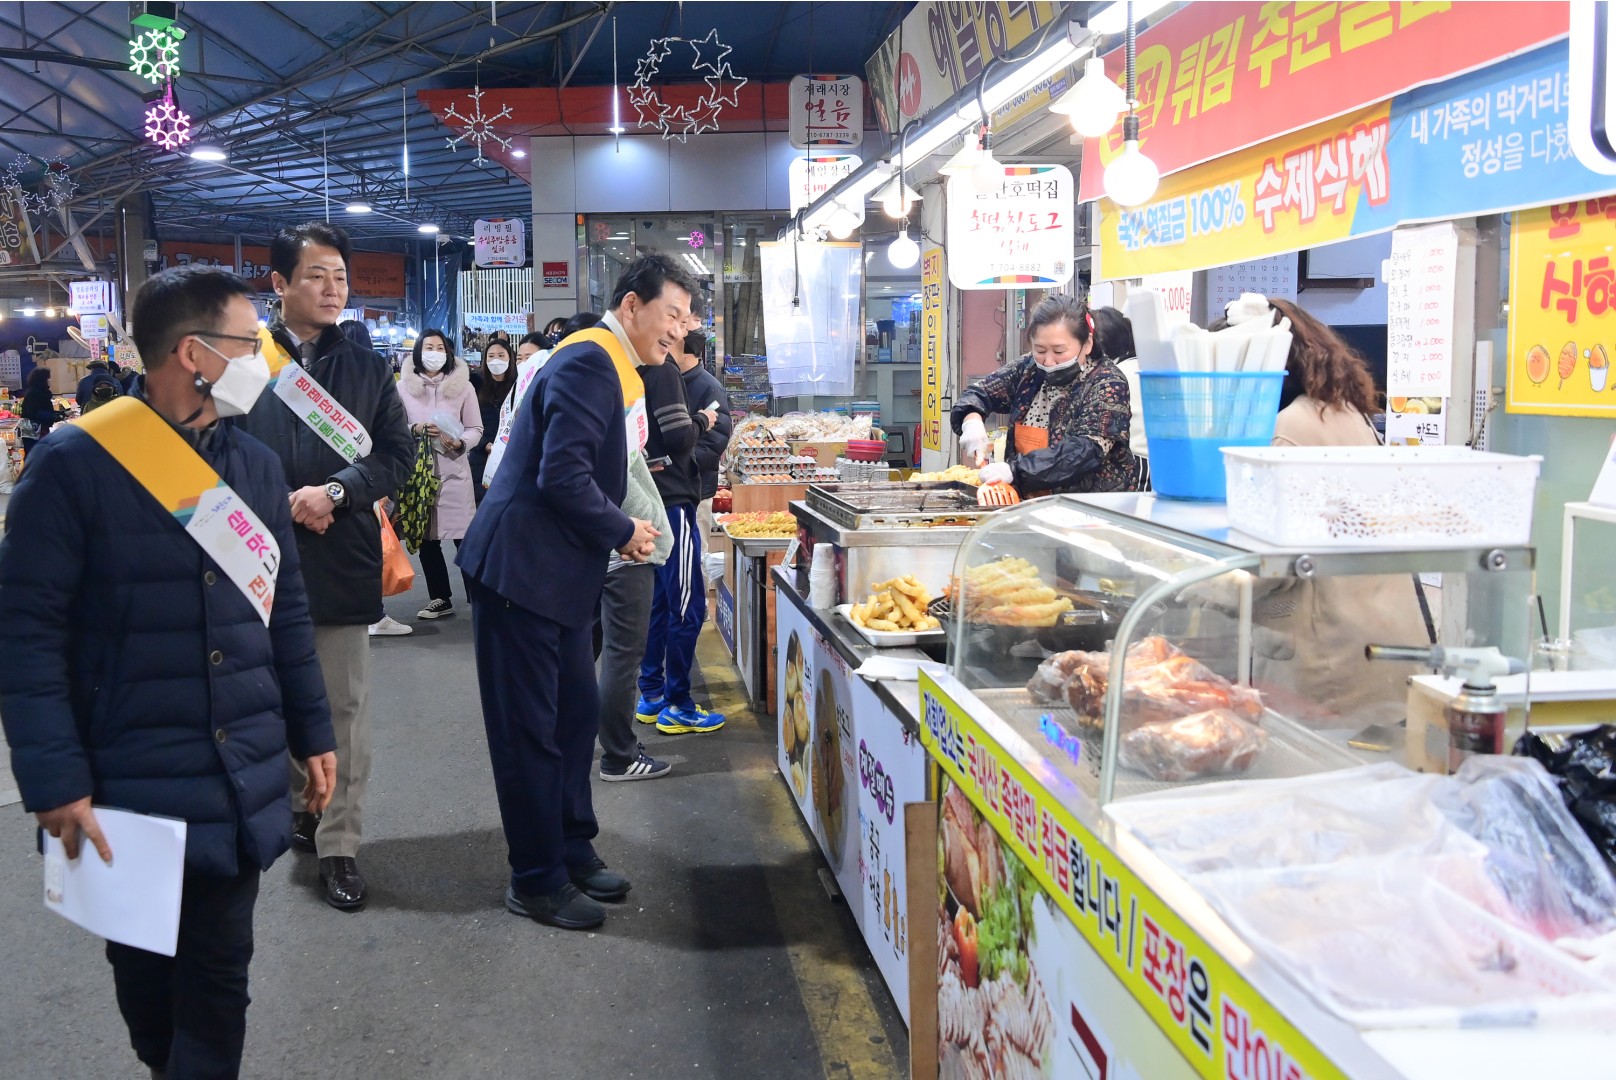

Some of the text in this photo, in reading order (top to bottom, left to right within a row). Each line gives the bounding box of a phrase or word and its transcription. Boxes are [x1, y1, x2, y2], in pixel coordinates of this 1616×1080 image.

[804, 84, 850, 96] 재래시장
[804, 98, 851, 122] 얼음
[1410, 108, 1429, 145] 내
[1432, 92, 1491, 141] 가족의
[1461, 131, 1525, 179] 정성을
[1190, 183, 1246, 236] 100%
[923, 691, 966, 776] 저희업소는
[966, 733, 1000, 815] 국내산
[1000, 766, 1039, 858] 족발만
[1041, 809, 1121, 954] 취급합니다
[1142, 913, 1213, 1054] 포장은
